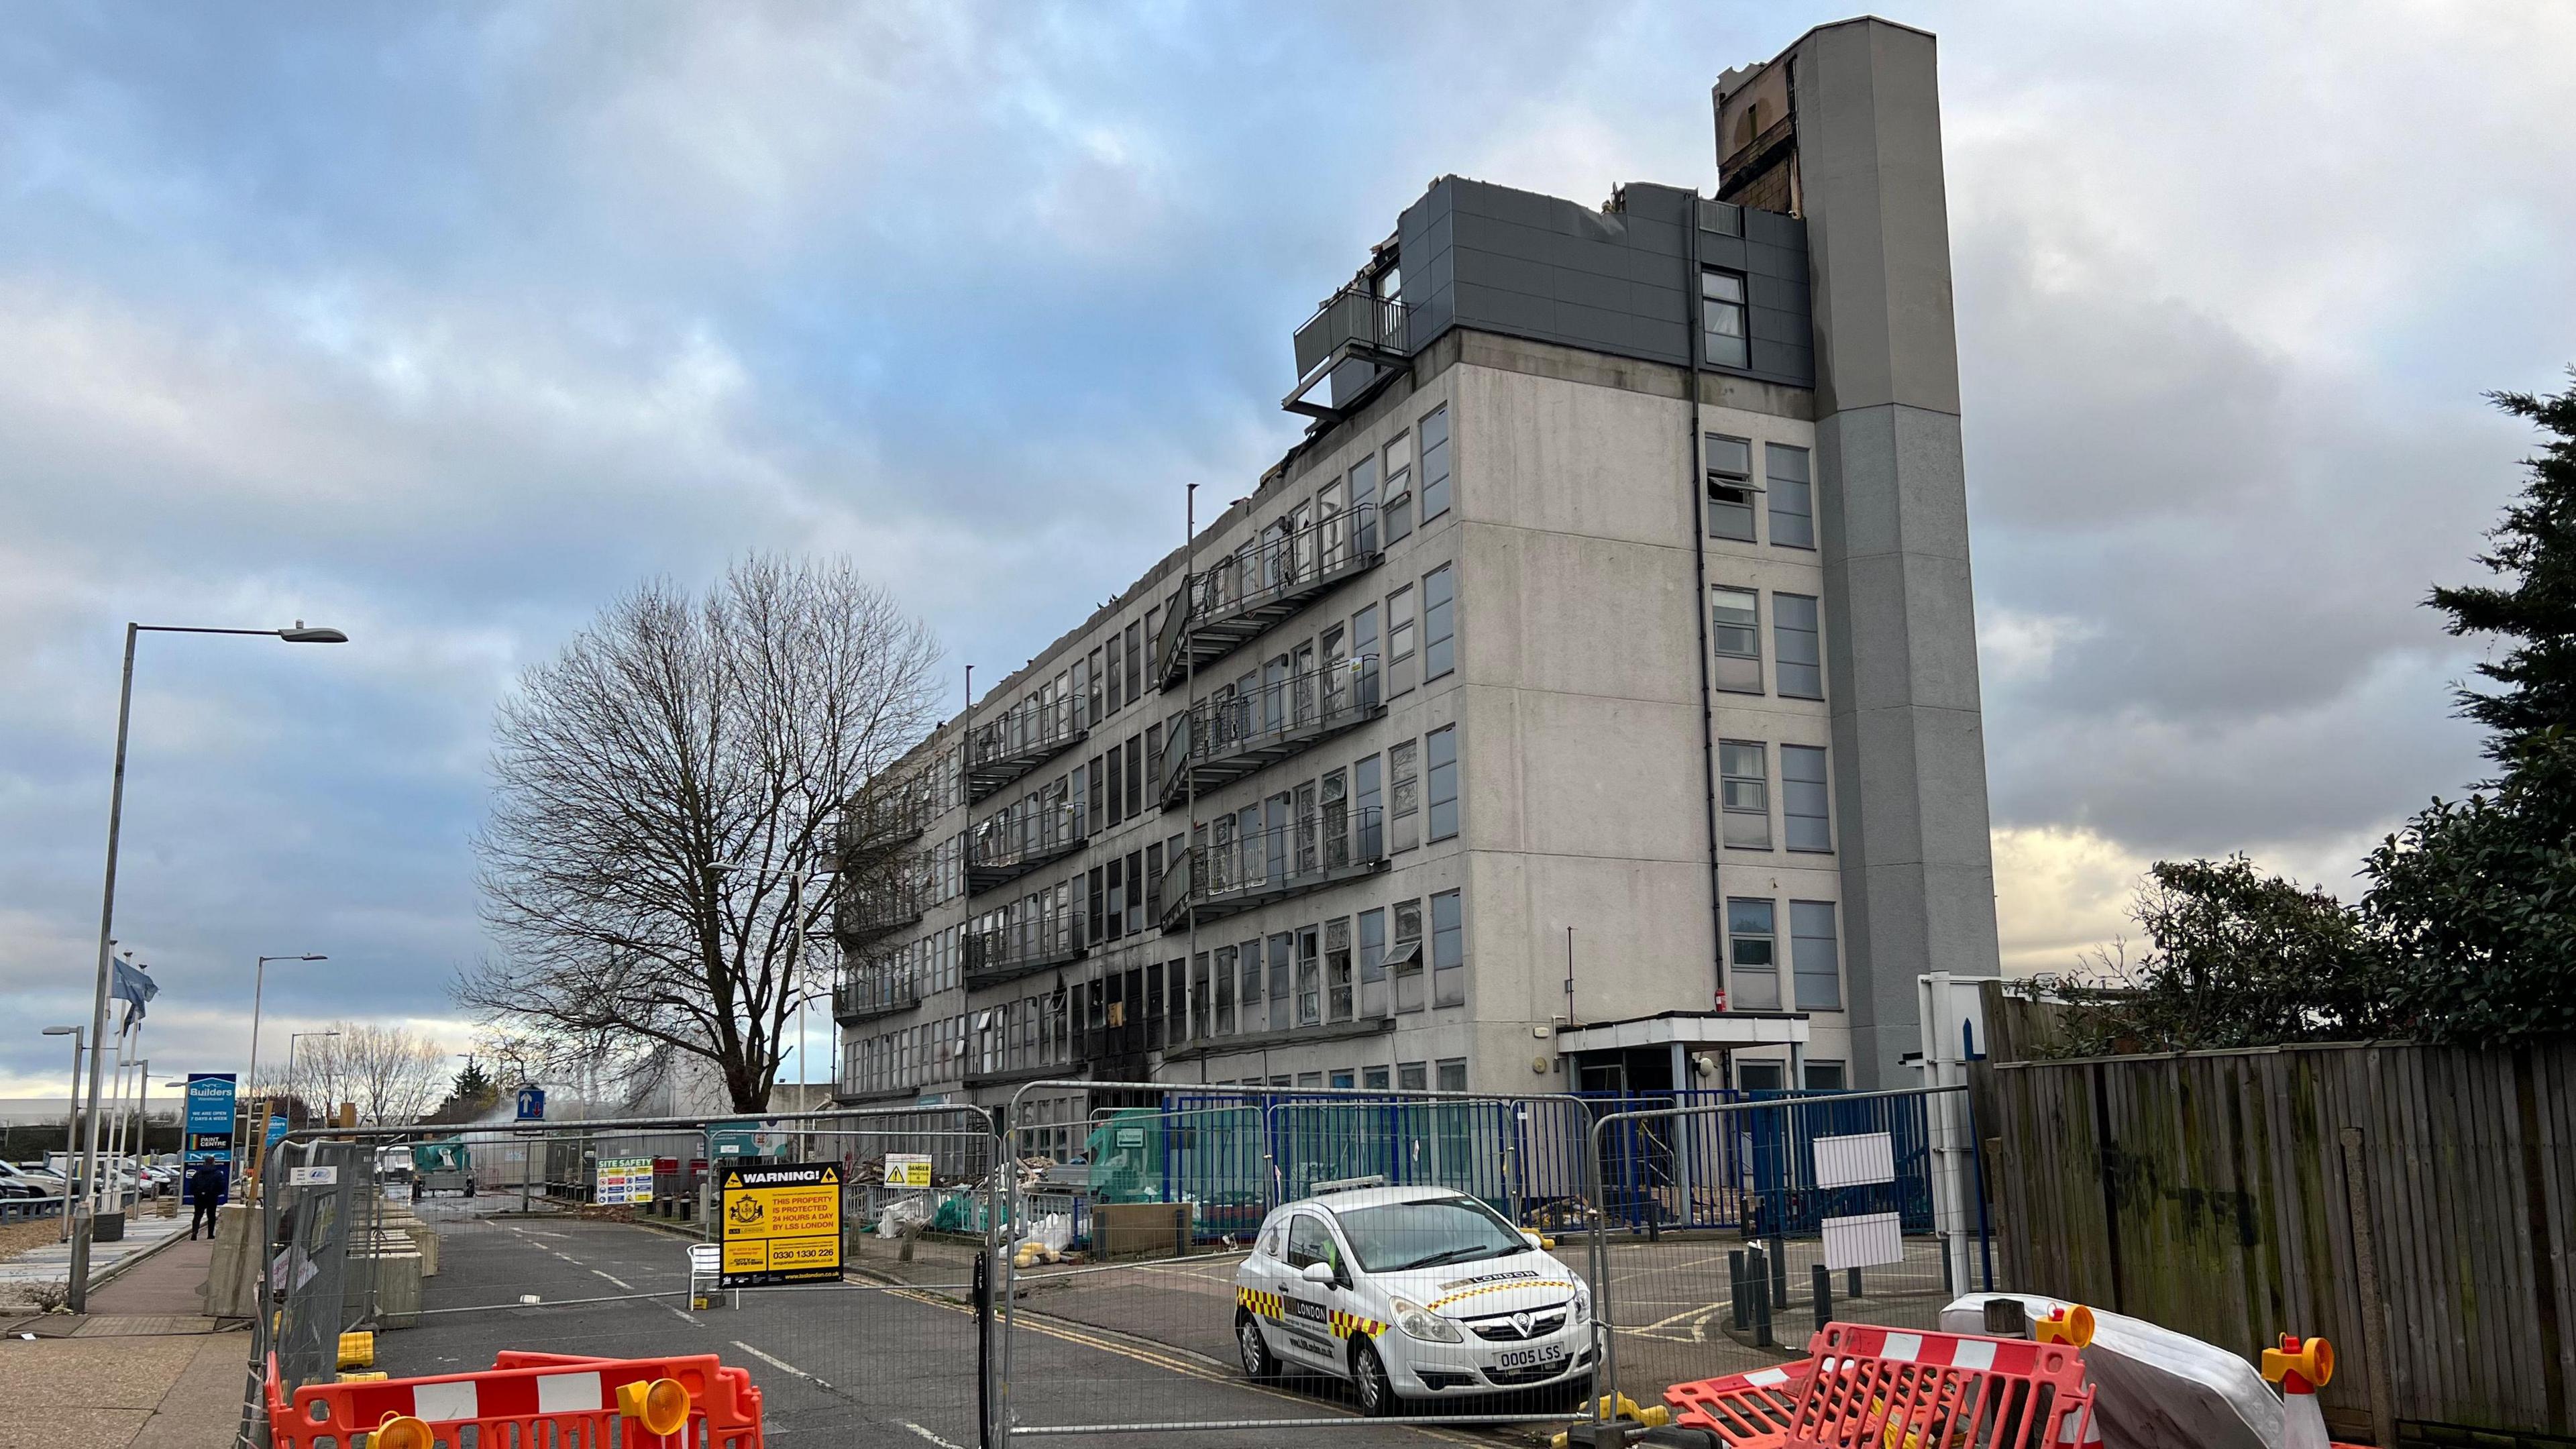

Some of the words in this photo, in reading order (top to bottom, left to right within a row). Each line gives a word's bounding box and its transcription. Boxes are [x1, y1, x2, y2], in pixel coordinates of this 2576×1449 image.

[190, 1088, 232, 1096] Builders
[599, 1160, 618, 1168] SITE
[619, 1158, 652, 1167] SAFETY
[743, 1171, 820, 1183] WARNING!
[792, 1196, 833, 1205] PROPERTY
[782, 1205, 828, 1213] PROTECTED
[801, 1221, 834, 1229] LONDON
[773, 1251, 794, 1259] 0330
[796, 1250, 816, 1258] 1330
[818, 1248, 834, 1256] 226
[1473, 1271, 1536, 1283] LONDON
[1297, 1302, 1326, 1320] LONDON
[1538, 1345, 1560, 1362] LSS
